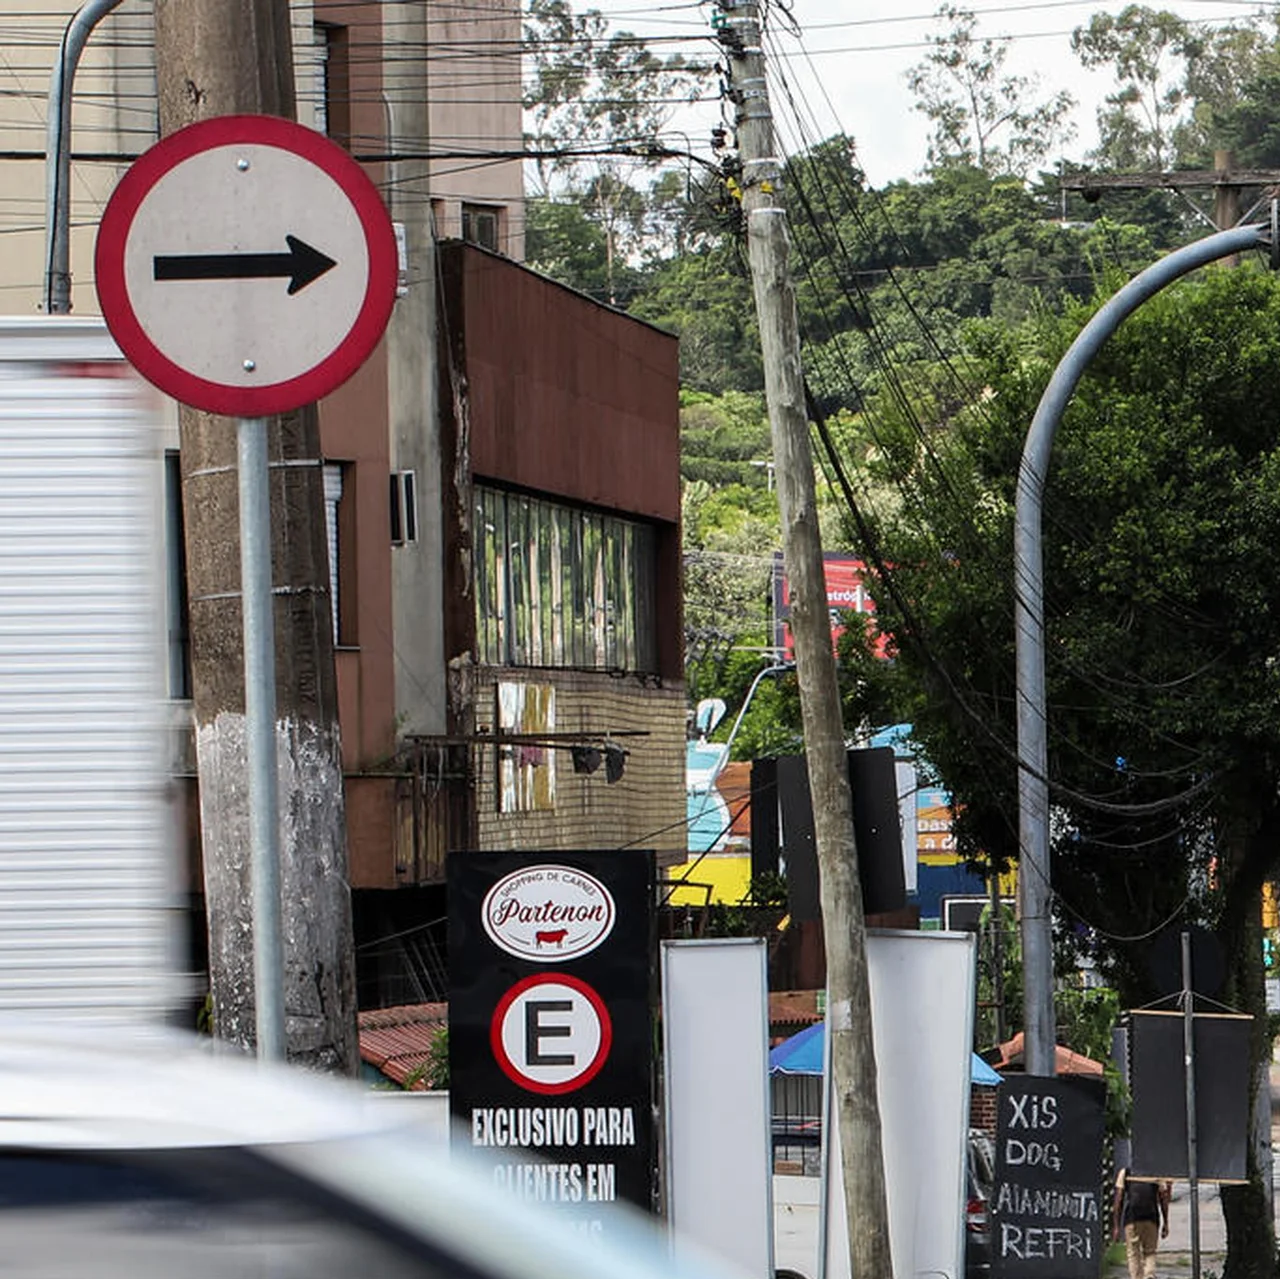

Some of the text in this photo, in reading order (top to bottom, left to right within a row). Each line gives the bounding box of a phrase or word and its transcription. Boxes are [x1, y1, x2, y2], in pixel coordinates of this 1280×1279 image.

[493, 898, 606, 926] Partenon
[525, 1001, 575, 1066] E
[472, 1107, 635, 1147] EXCLUSIVO PARA
[1006, 1139, 1062, 1171] DOG
[586, 1163, 615, 1201] EM
